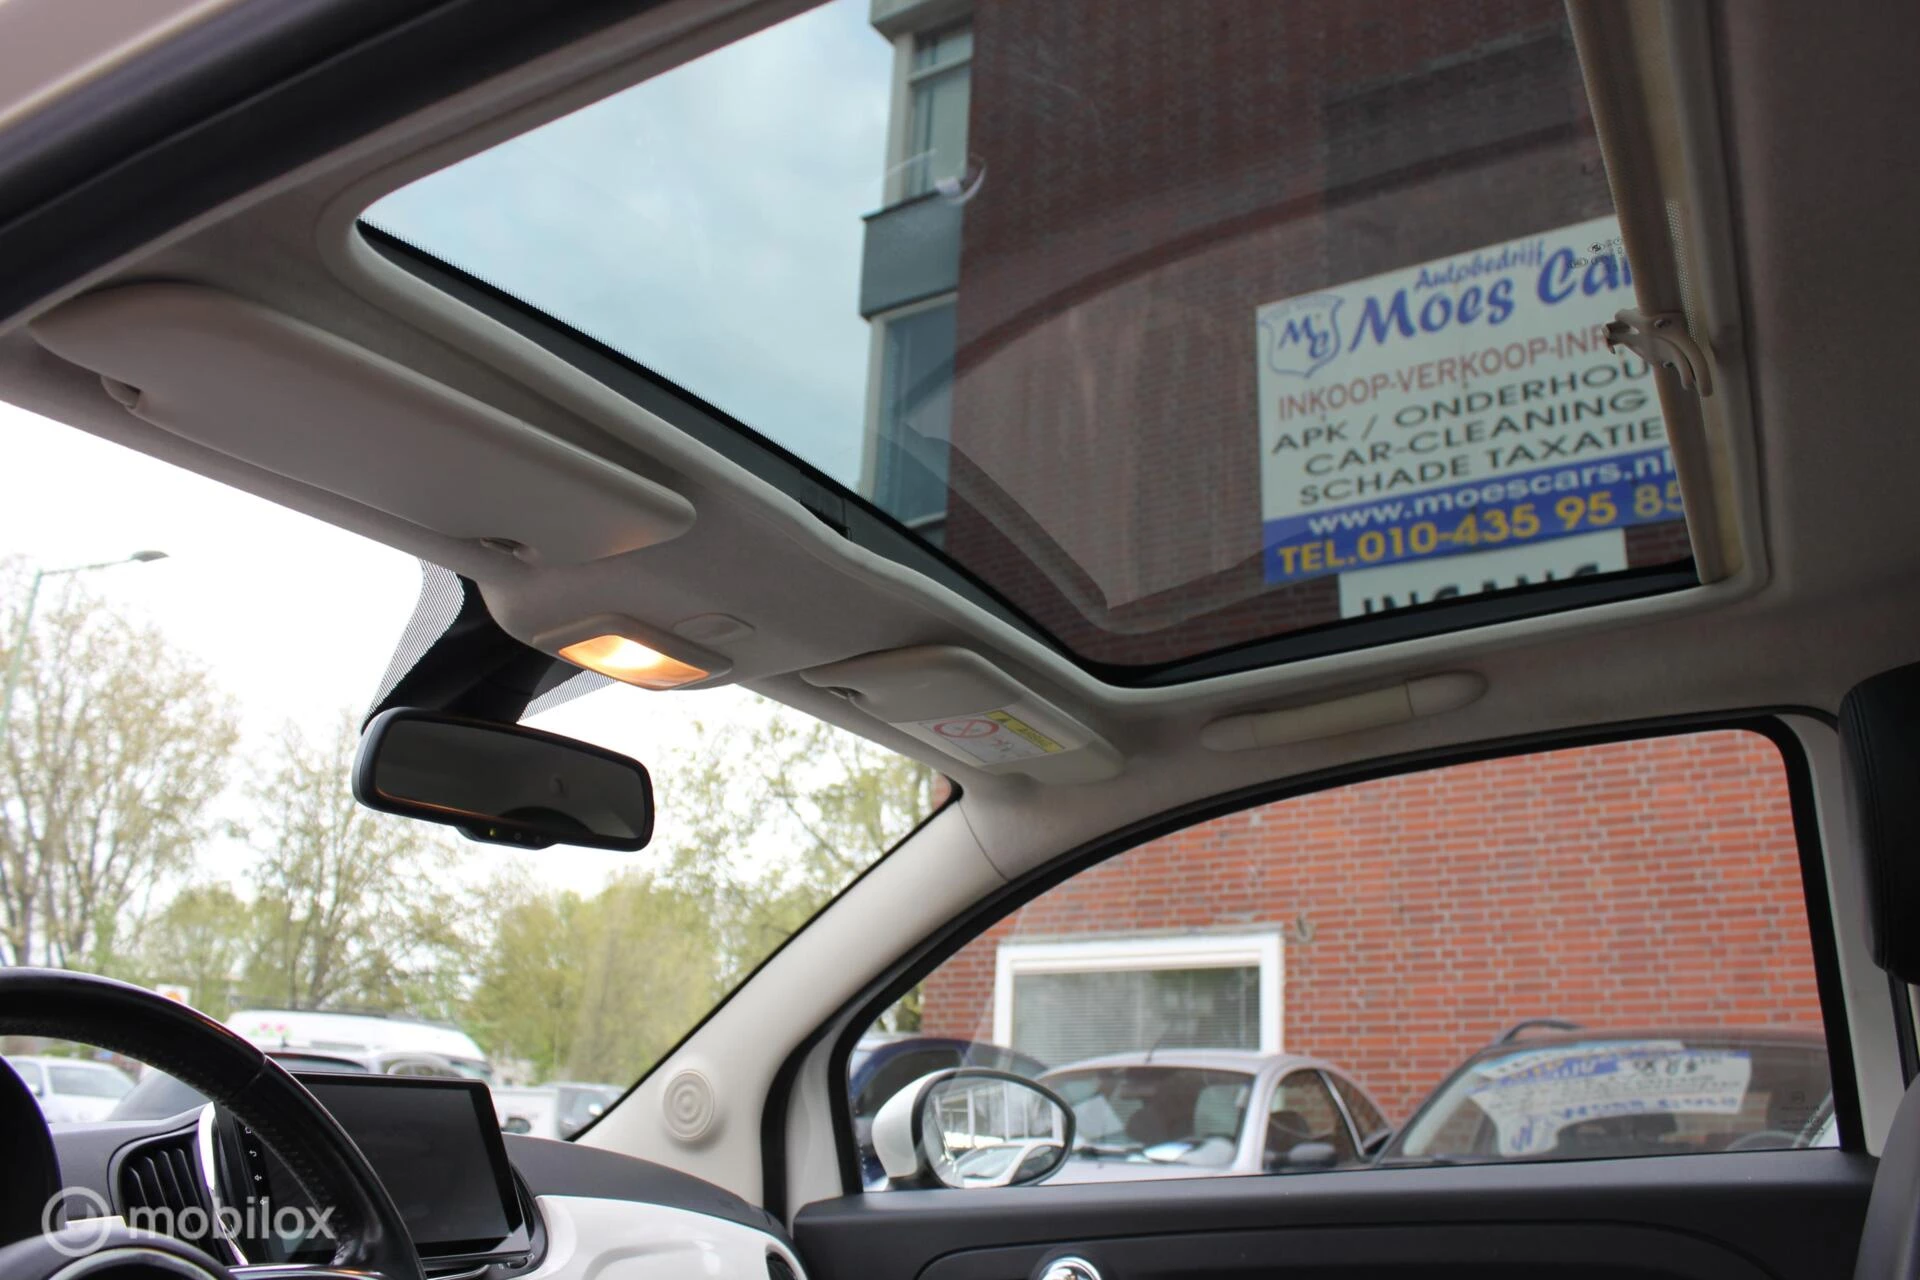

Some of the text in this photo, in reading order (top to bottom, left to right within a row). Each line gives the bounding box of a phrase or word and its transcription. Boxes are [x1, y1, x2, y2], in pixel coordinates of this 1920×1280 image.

[1414, 241, 1545, 290] Autobedrijf
[1349, 278, 1513, 352] Moes
[1272, 421, 1349, 453] APK
[1361, 414, 1378, 440] /
[1301, 416, 1663, 505] SCHADE TAXATIE
[1305, 389, 1646, 476] CAR-CLEANING
[1279, 503, 1541, 574] TEL.010-435
[1555, 491, 1617, 530] 95
[1308, 451, 1674, 534] www.moescars.nl
